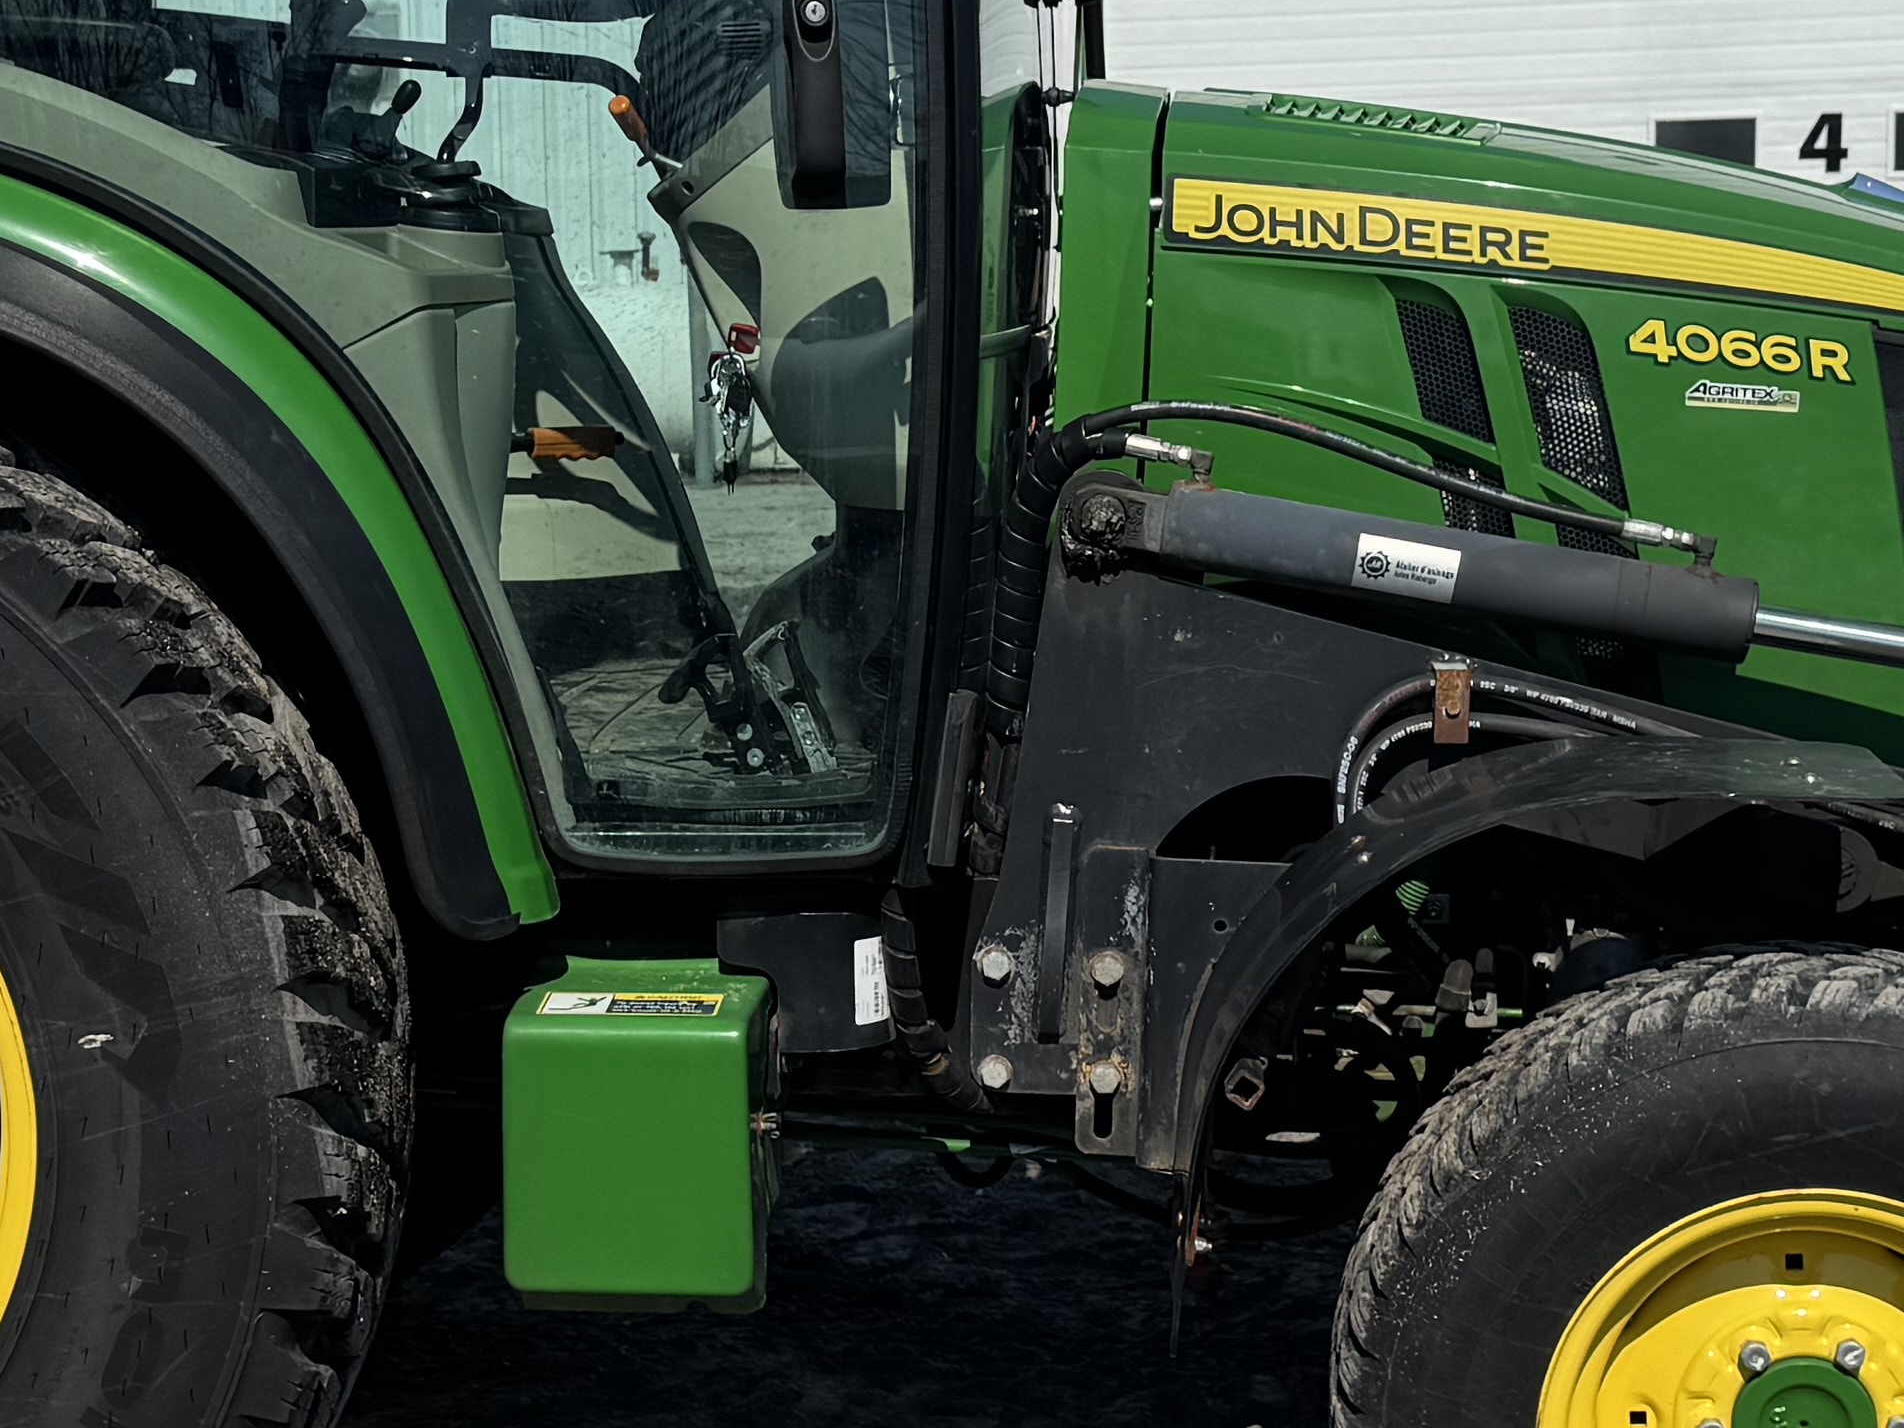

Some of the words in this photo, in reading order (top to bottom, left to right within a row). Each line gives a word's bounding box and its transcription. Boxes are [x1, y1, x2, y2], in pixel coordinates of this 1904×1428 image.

[1797, 111, 1849, 174] 4
[1194, 192, 1346, 253] JOHN
[1358, 205, 1551, 266] DEERE
[1689, 382, 1776, 400] AGRITEX
